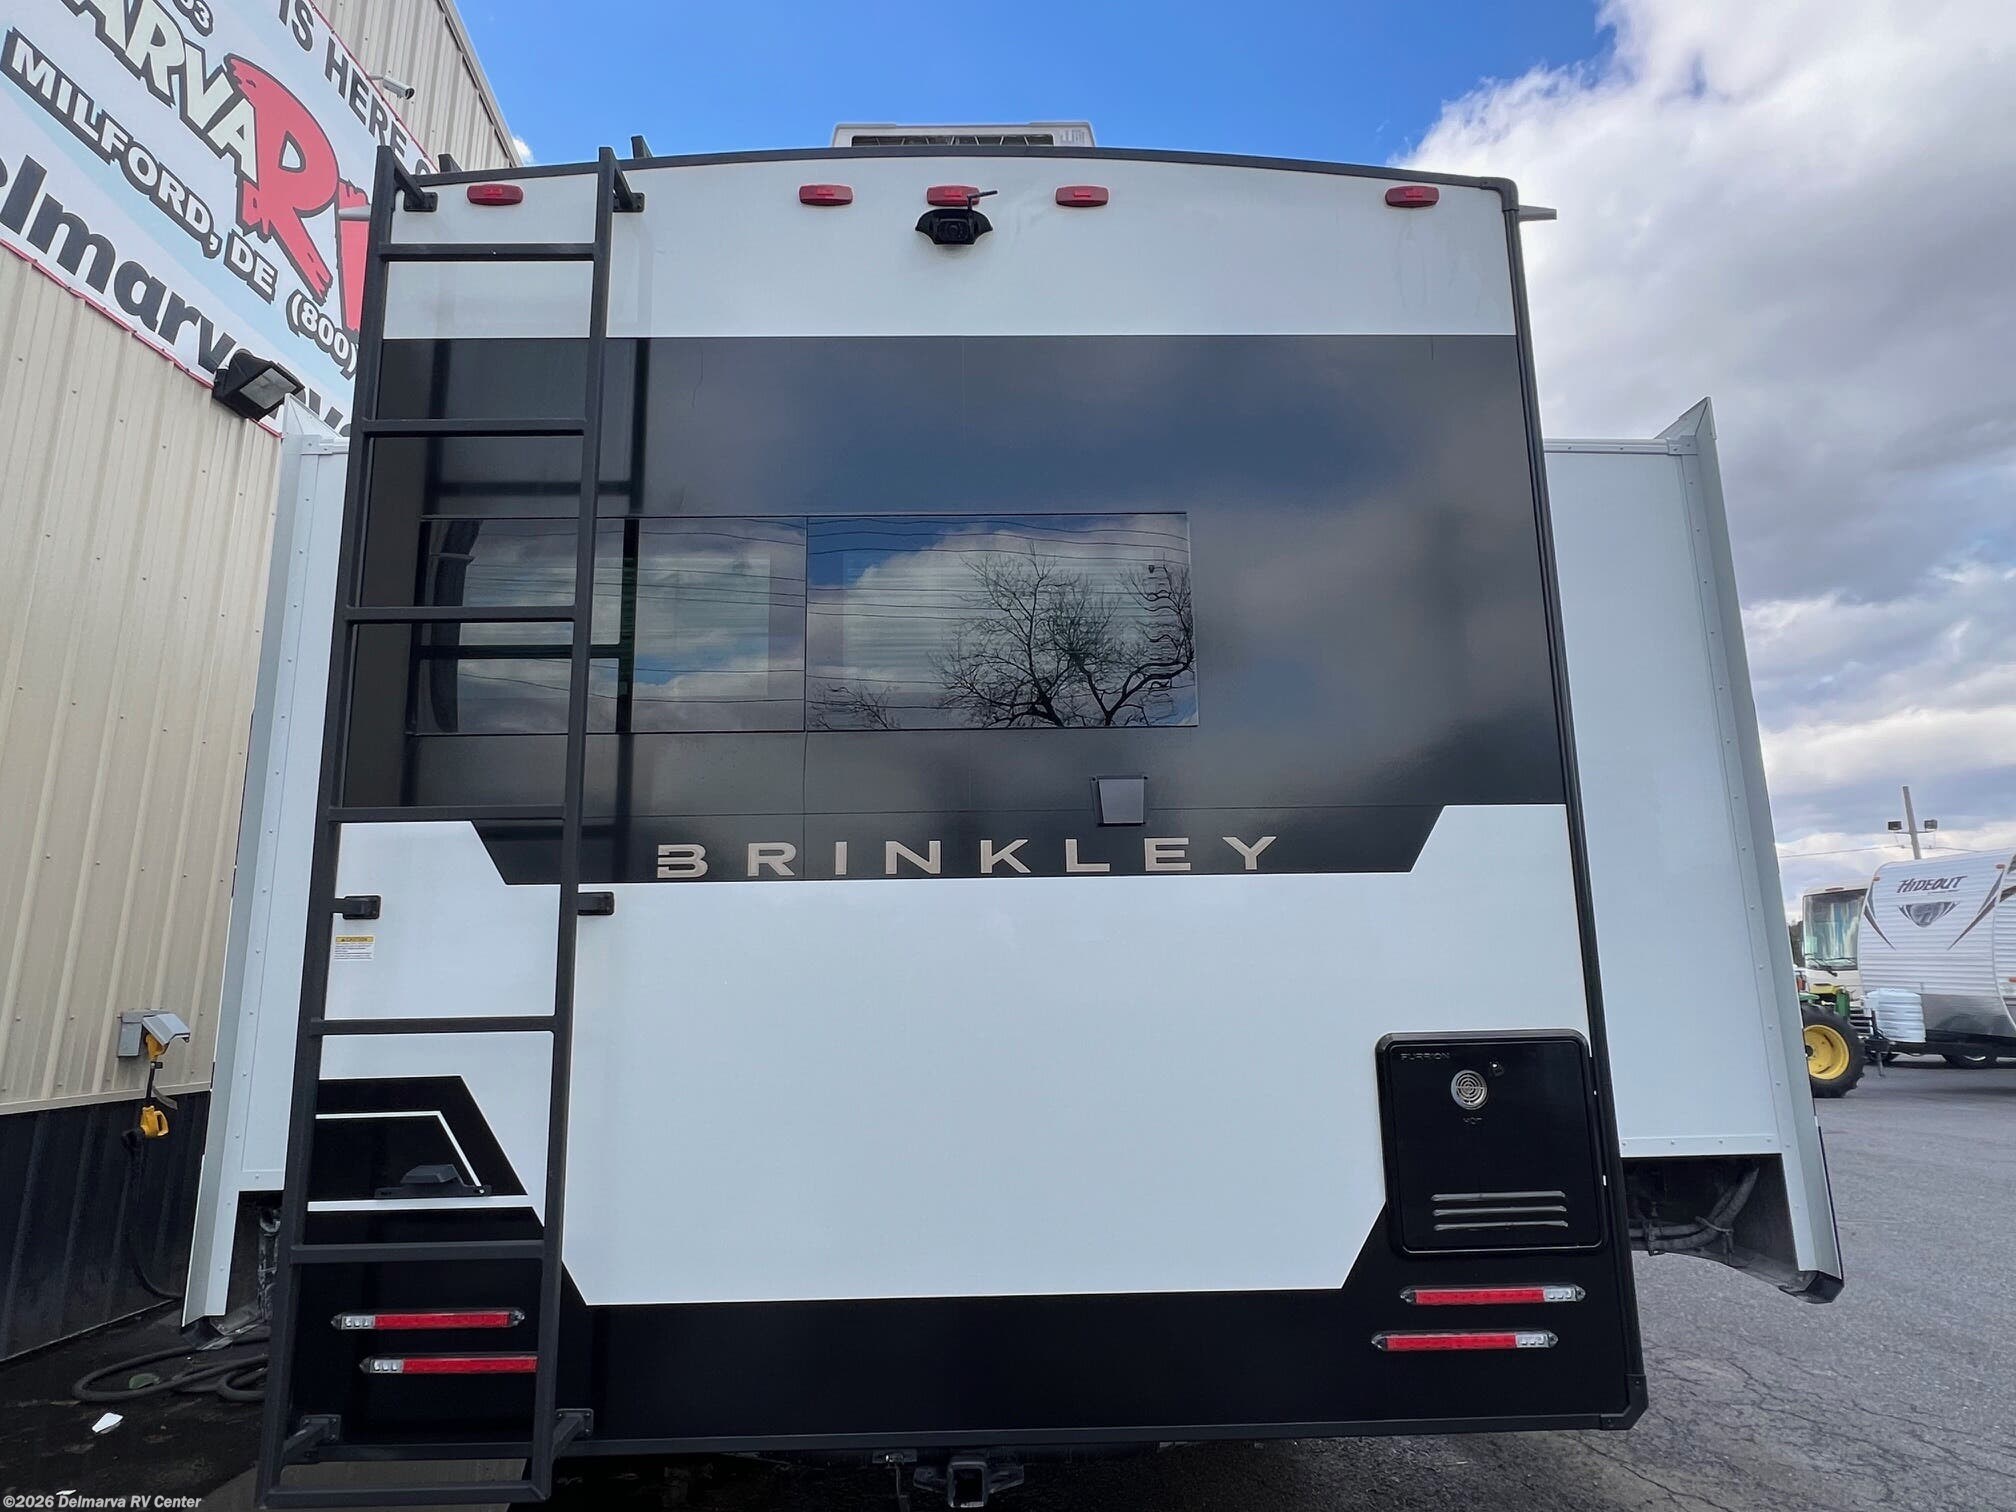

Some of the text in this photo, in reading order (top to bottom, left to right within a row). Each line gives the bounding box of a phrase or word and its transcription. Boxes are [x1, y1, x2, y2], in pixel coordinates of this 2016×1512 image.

[325, 36, 407, 158] HERE
[5, 31, 358, 377] MILFORD, DE (800)
[657, 836, 1277, 879] BRINKLEY
[1897, 875, 1968, 893] HIDEOUT
